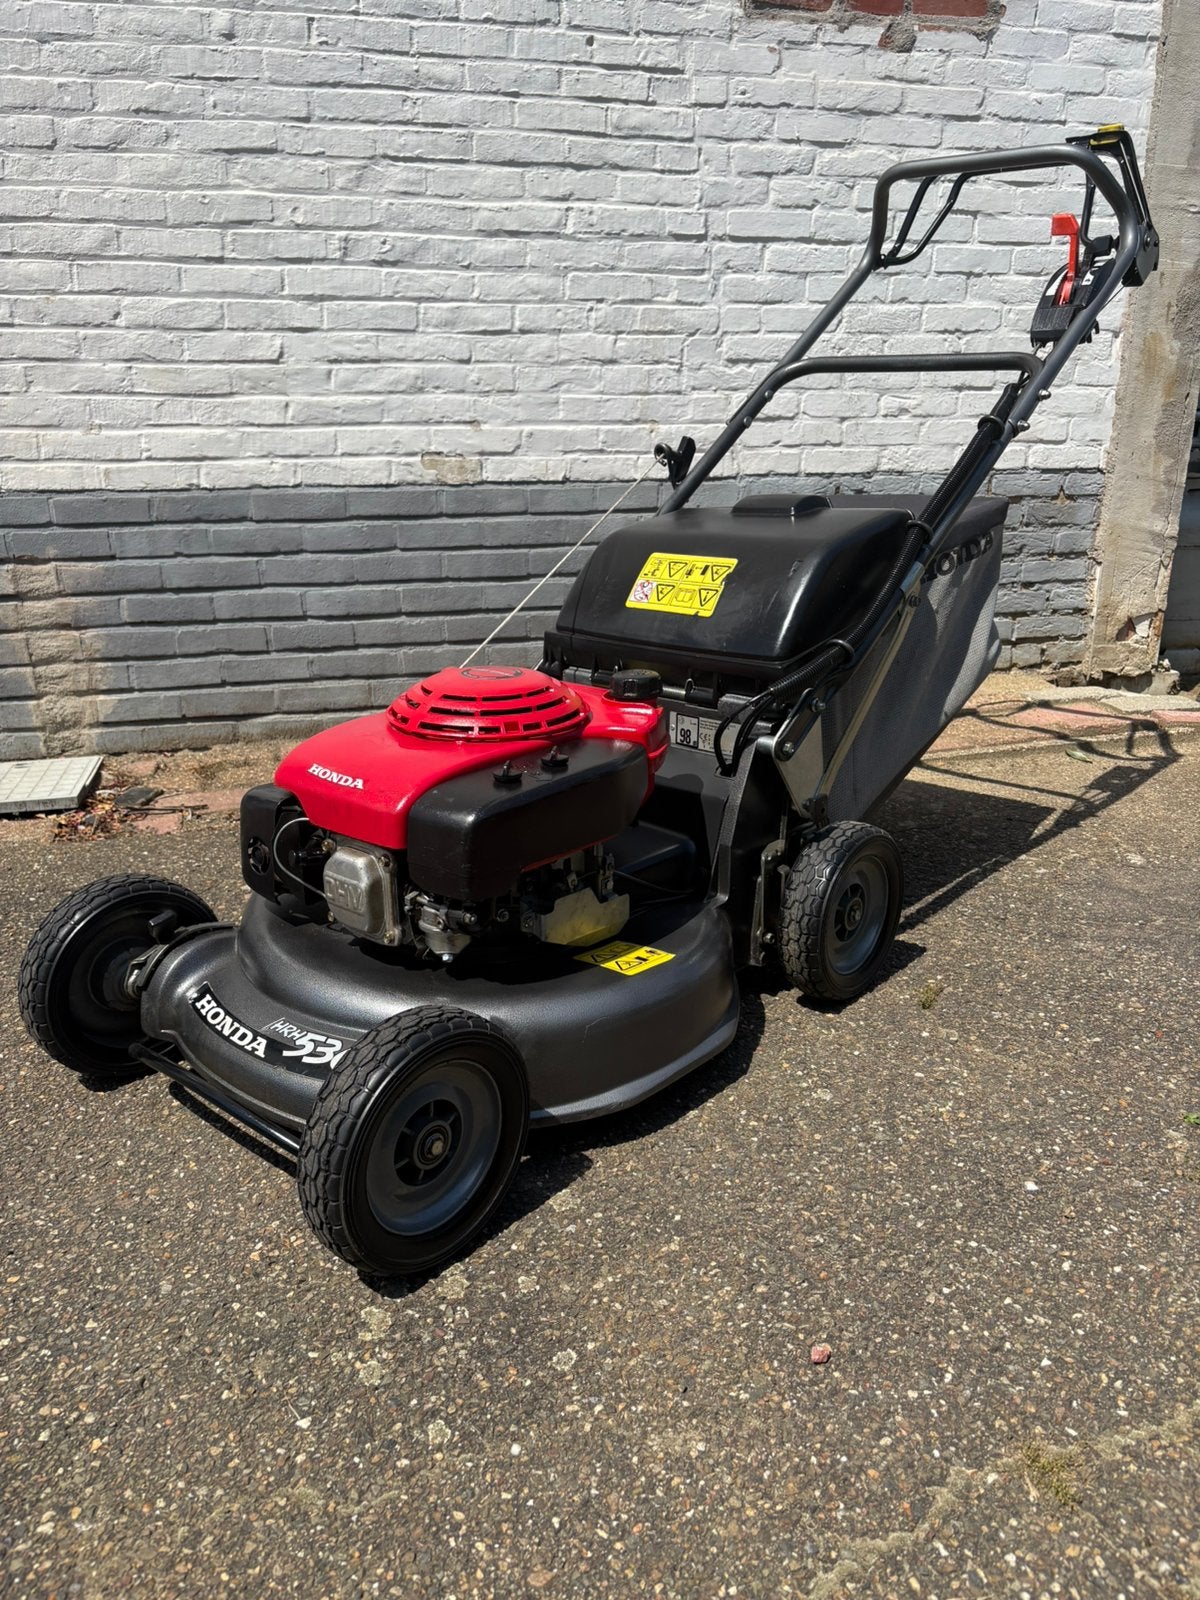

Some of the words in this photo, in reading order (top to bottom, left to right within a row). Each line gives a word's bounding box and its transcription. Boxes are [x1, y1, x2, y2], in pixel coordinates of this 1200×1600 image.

[679, 728, 692, 744] 98
[307, 763, 364, 790] HONDA
[195, 993, 269, 1059] HONDA
